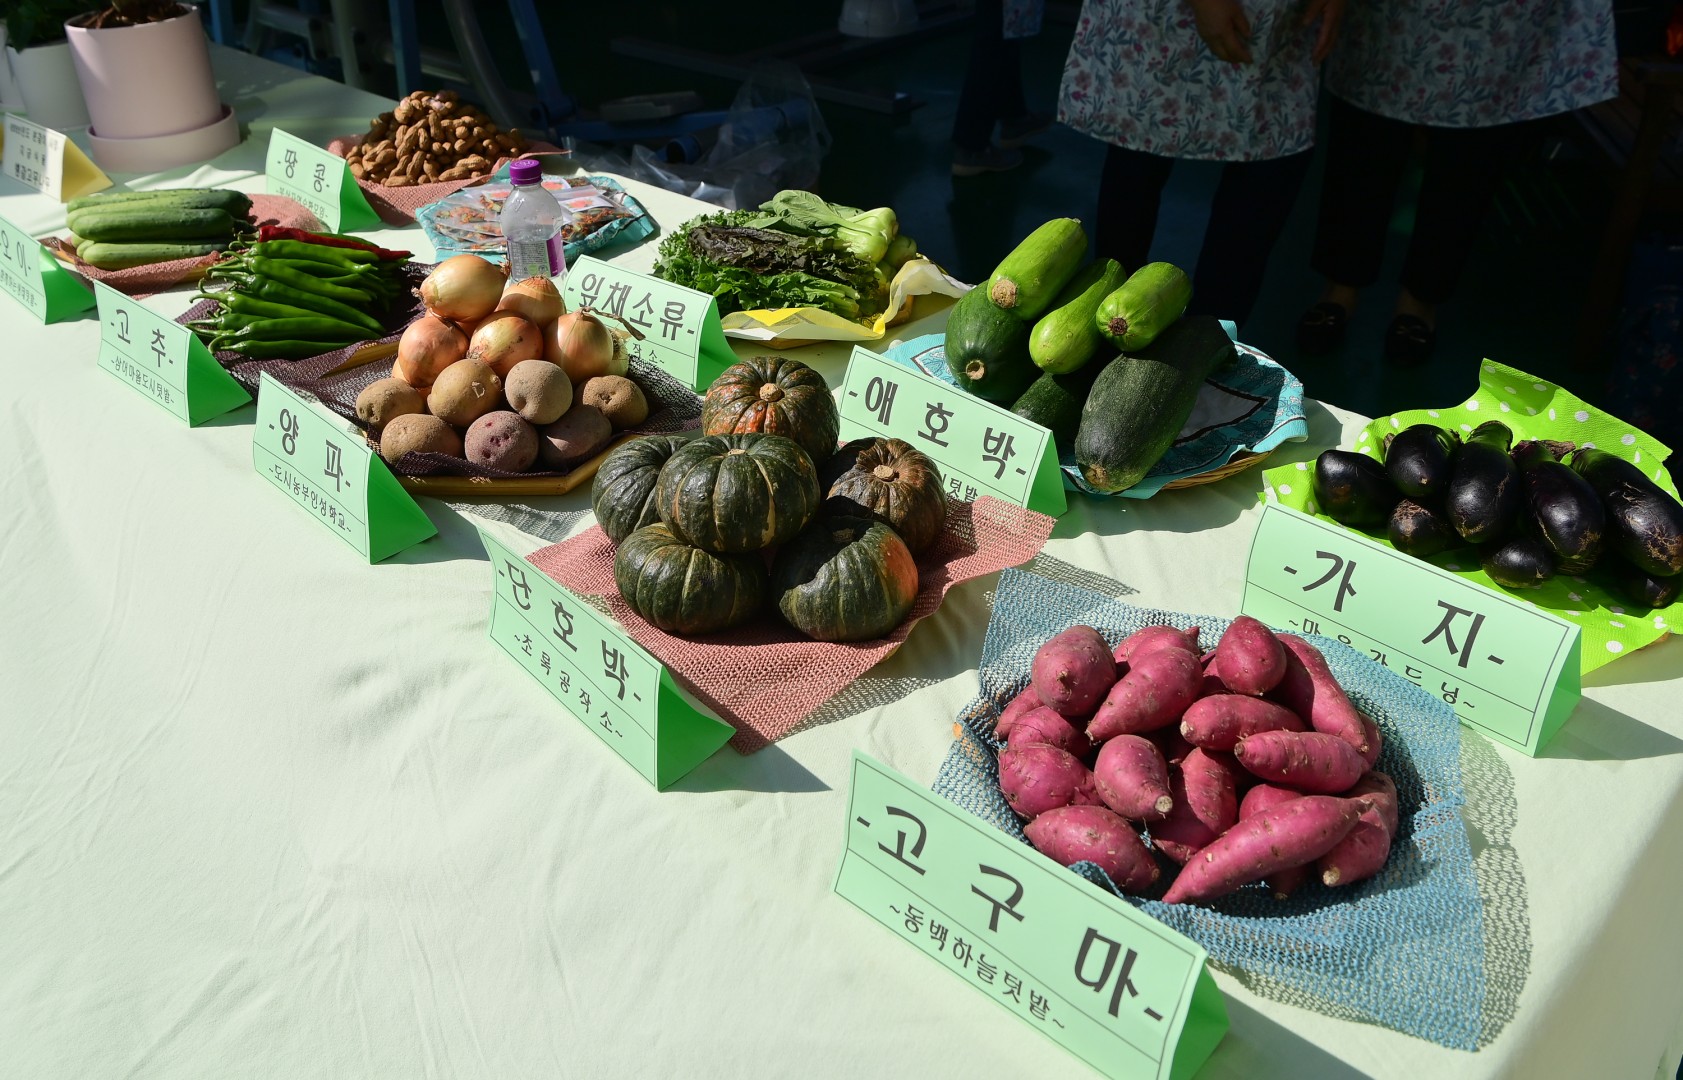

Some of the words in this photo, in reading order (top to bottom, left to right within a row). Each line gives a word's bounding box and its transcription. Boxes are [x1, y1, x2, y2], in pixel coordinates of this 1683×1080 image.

[277, 149, 330, 193] -땅콩-
[111, 309, 174, 368] -고추-
[269, 408, 351, 493] -양파-
[848, 376, 1027, 480] -애호박-
[498, 558, 642, 702] -단호박-
[1283, 550, 1504, 669] -가지-
[514, 634, 624, 738] ~초록공작소~
[856, 805, 1164, 1022] -고구마-
[889, 903, 1066, 1029] ~동백하늘텃밭~
